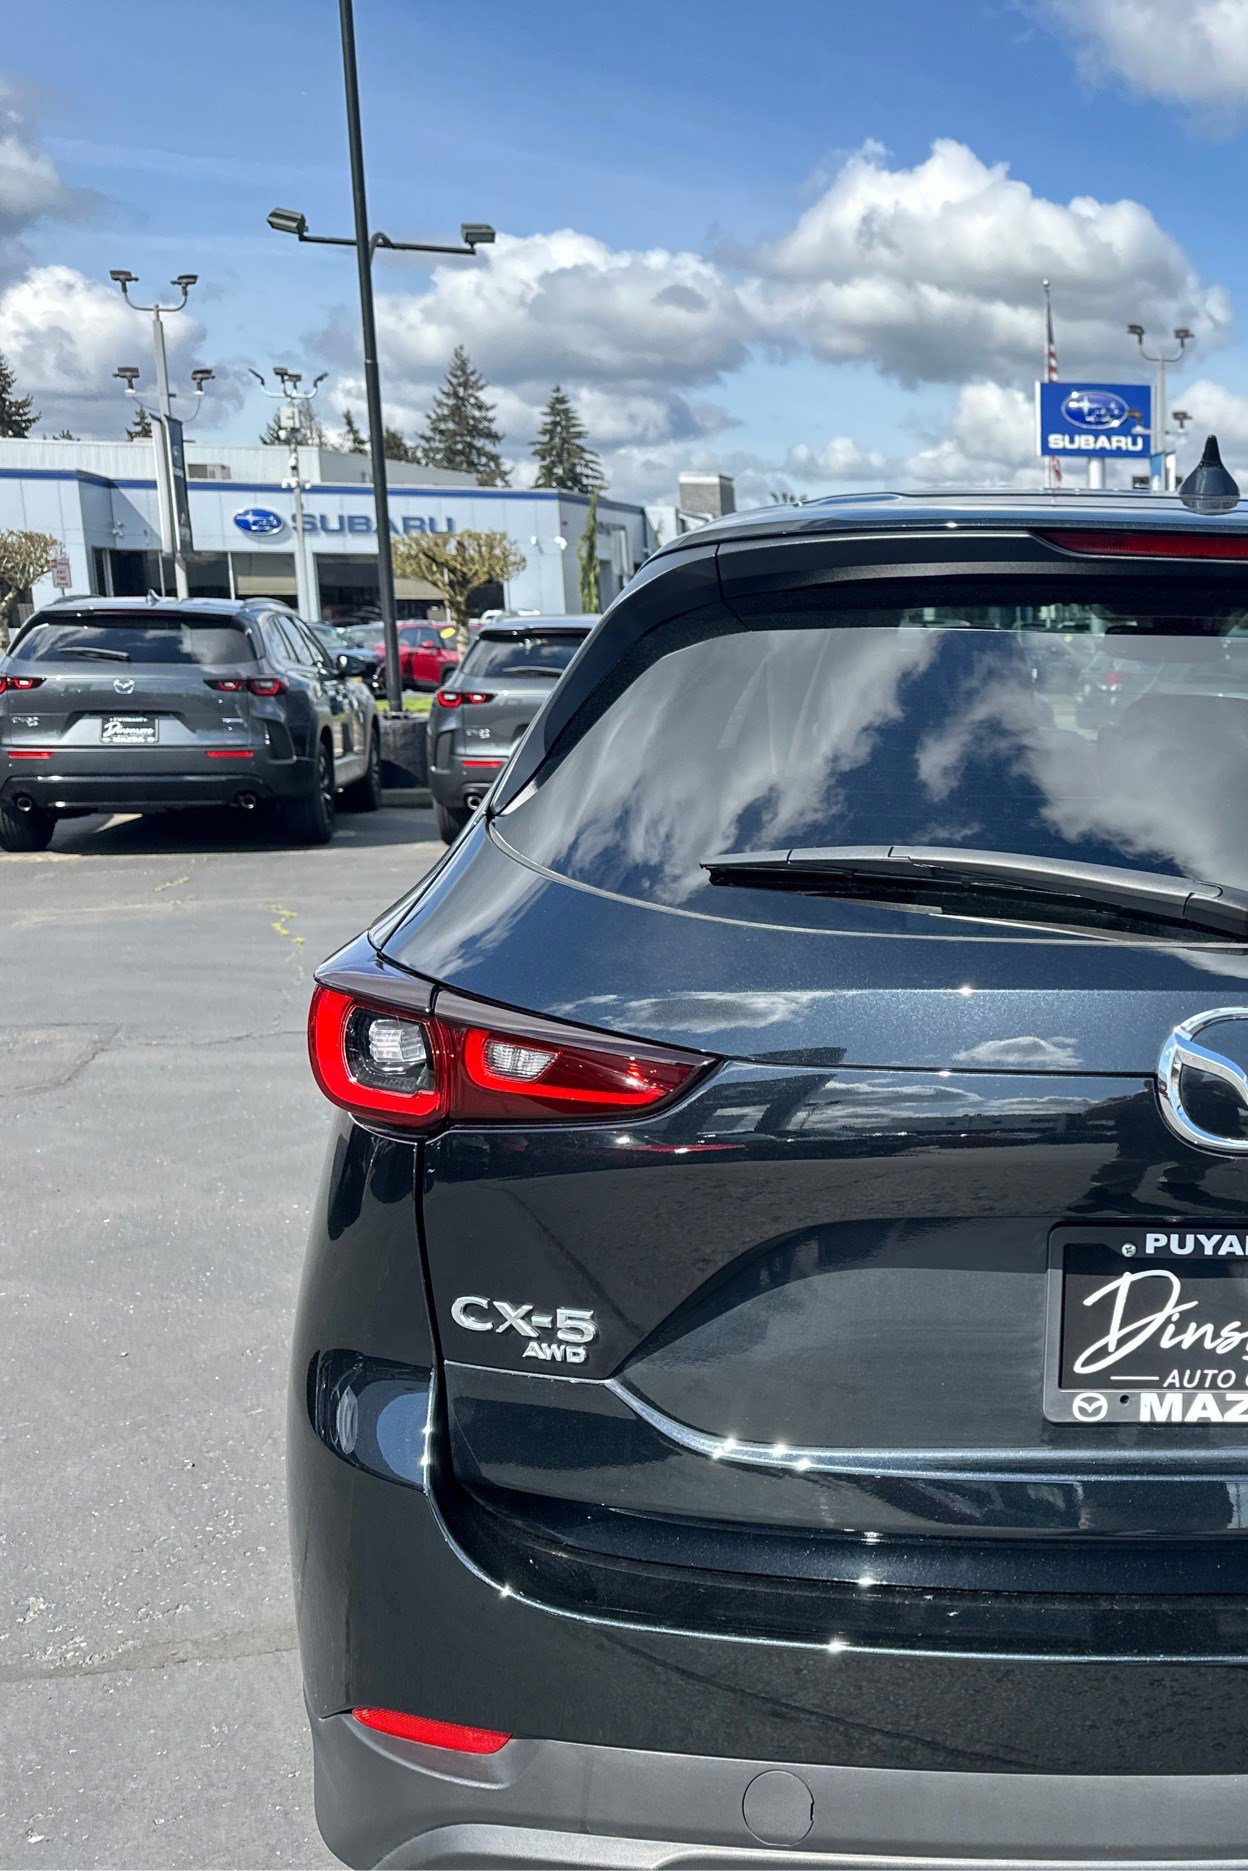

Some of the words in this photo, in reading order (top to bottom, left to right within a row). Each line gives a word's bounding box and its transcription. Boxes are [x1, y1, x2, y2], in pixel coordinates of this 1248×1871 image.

[1047, 433, 1143, 451] SUBARU
[451, 1295, 598, 1343] CX-5
[522, 1341, 587, 1364] AWD
[1163, 1369, 1236, 1389] AUTO
